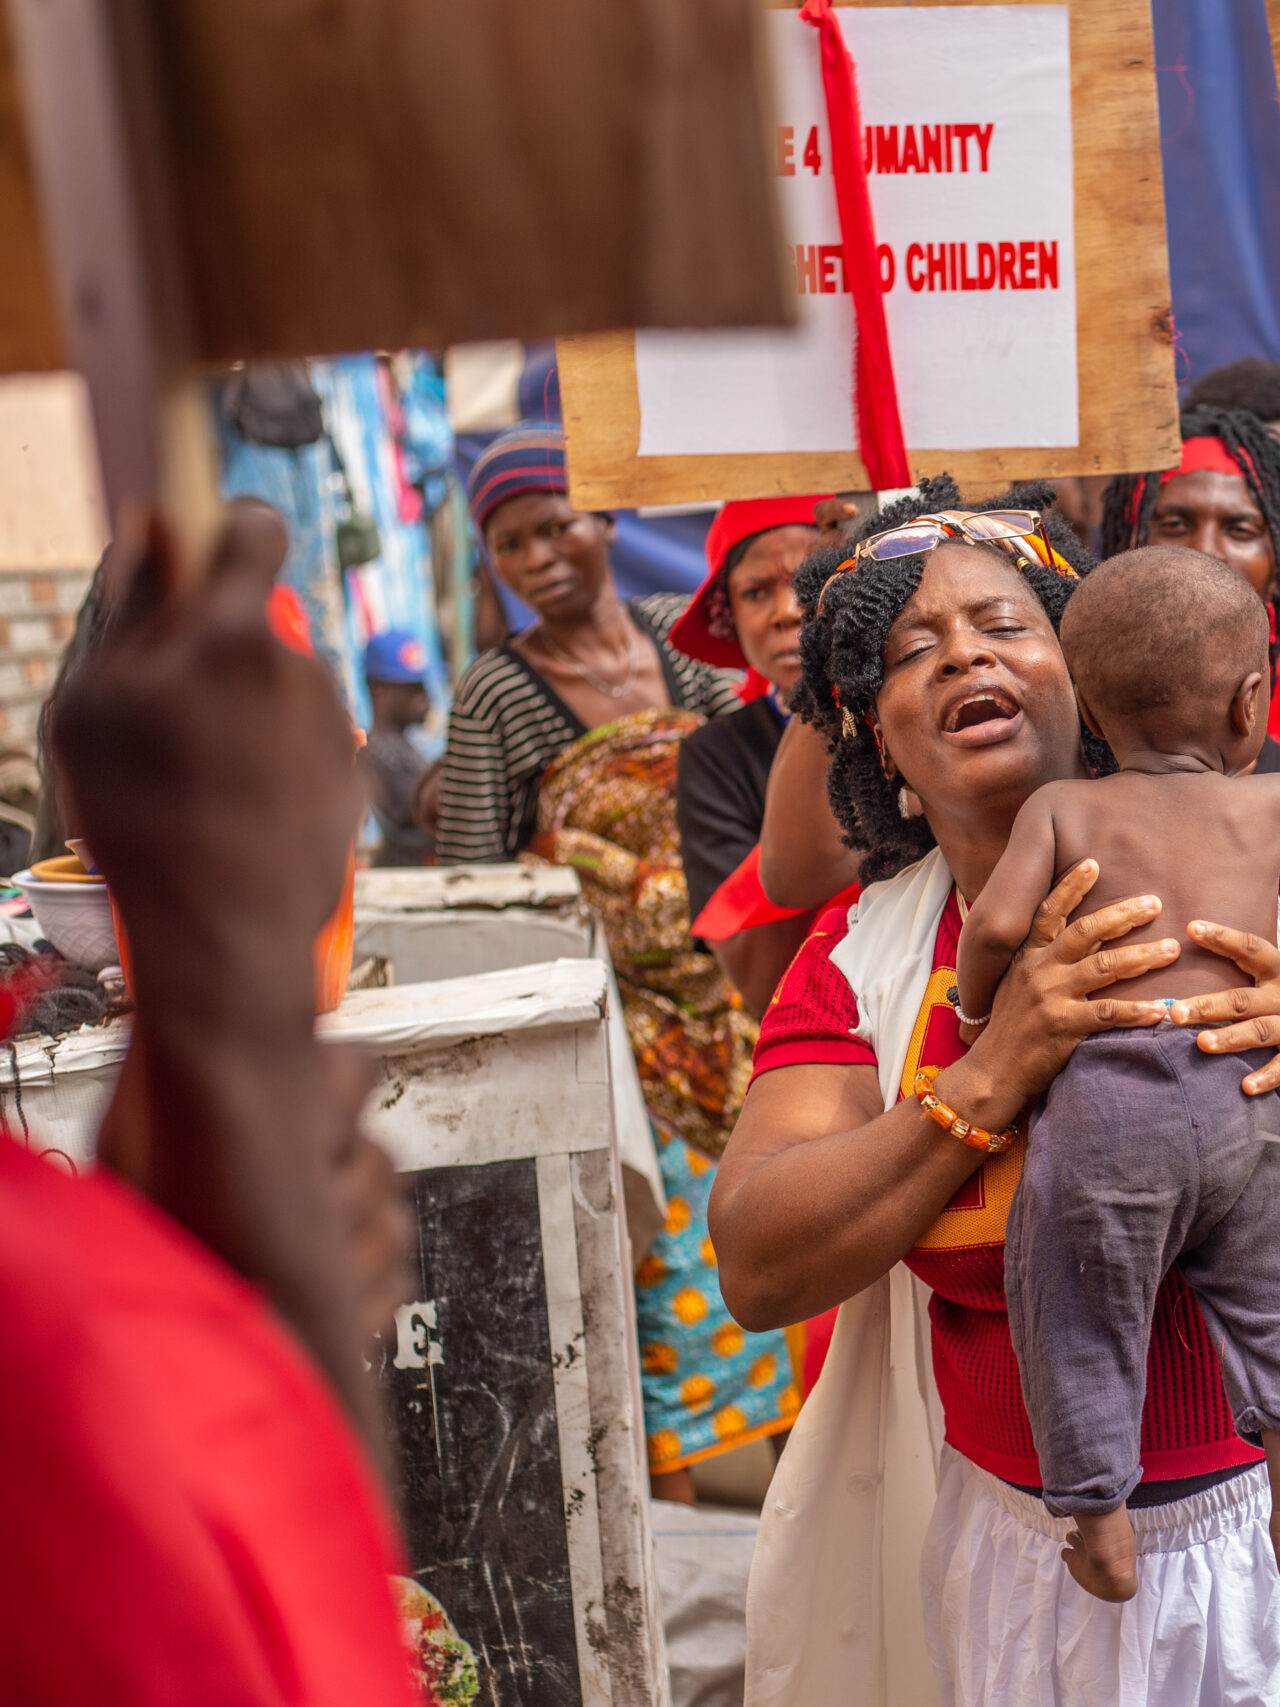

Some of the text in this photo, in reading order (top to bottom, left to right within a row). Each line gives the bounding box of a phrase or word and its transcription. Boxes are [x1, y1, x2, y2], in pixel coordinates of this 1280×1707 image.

[802, 125, 823, 176] 4
[860, 123, 994, 174] UMANITY
[905, 240, 1060, 293] CHILDREN
